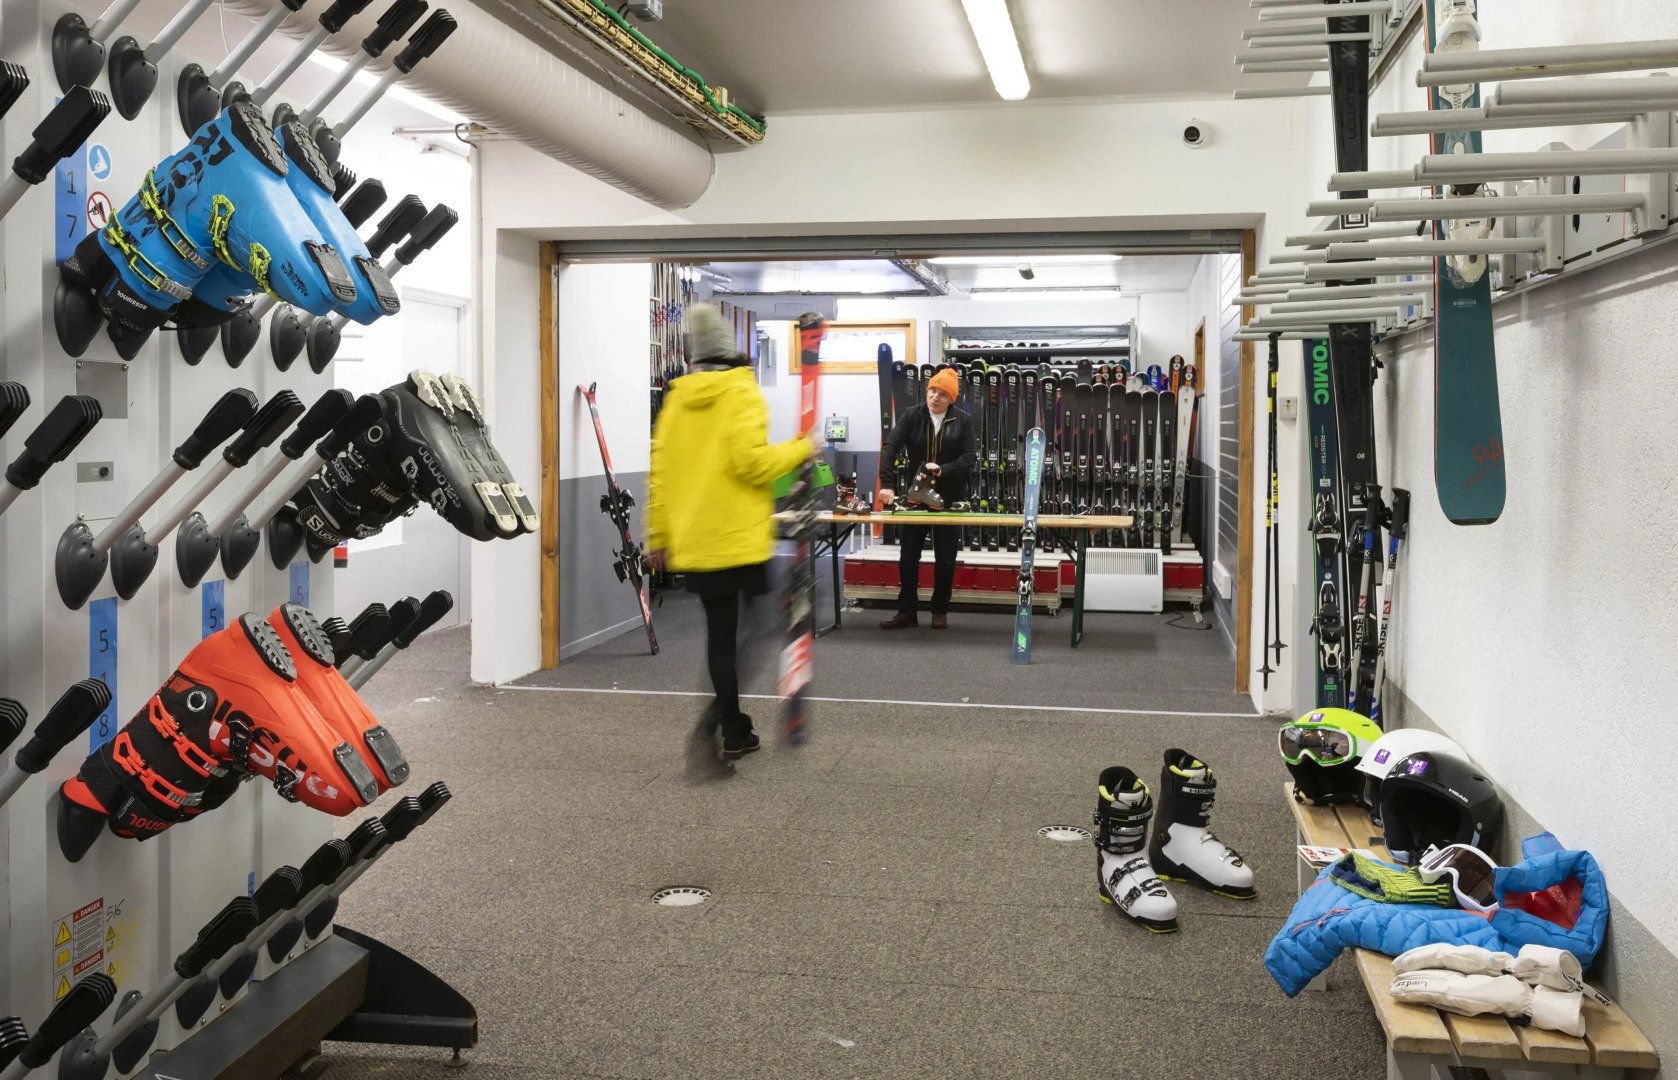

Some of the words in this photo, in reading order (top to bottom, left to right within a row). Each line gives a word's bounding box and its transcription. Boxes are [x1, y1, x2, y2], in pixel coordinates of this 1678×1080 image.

[1028, 447, 1040, 485] ATOMIC
[418, 446, 461, 508] salomon
[1448, 788, 1469, 803] HEAD
[80, 901, 101, 917] DANGER
[81, 953, 101, 970] DANGER
